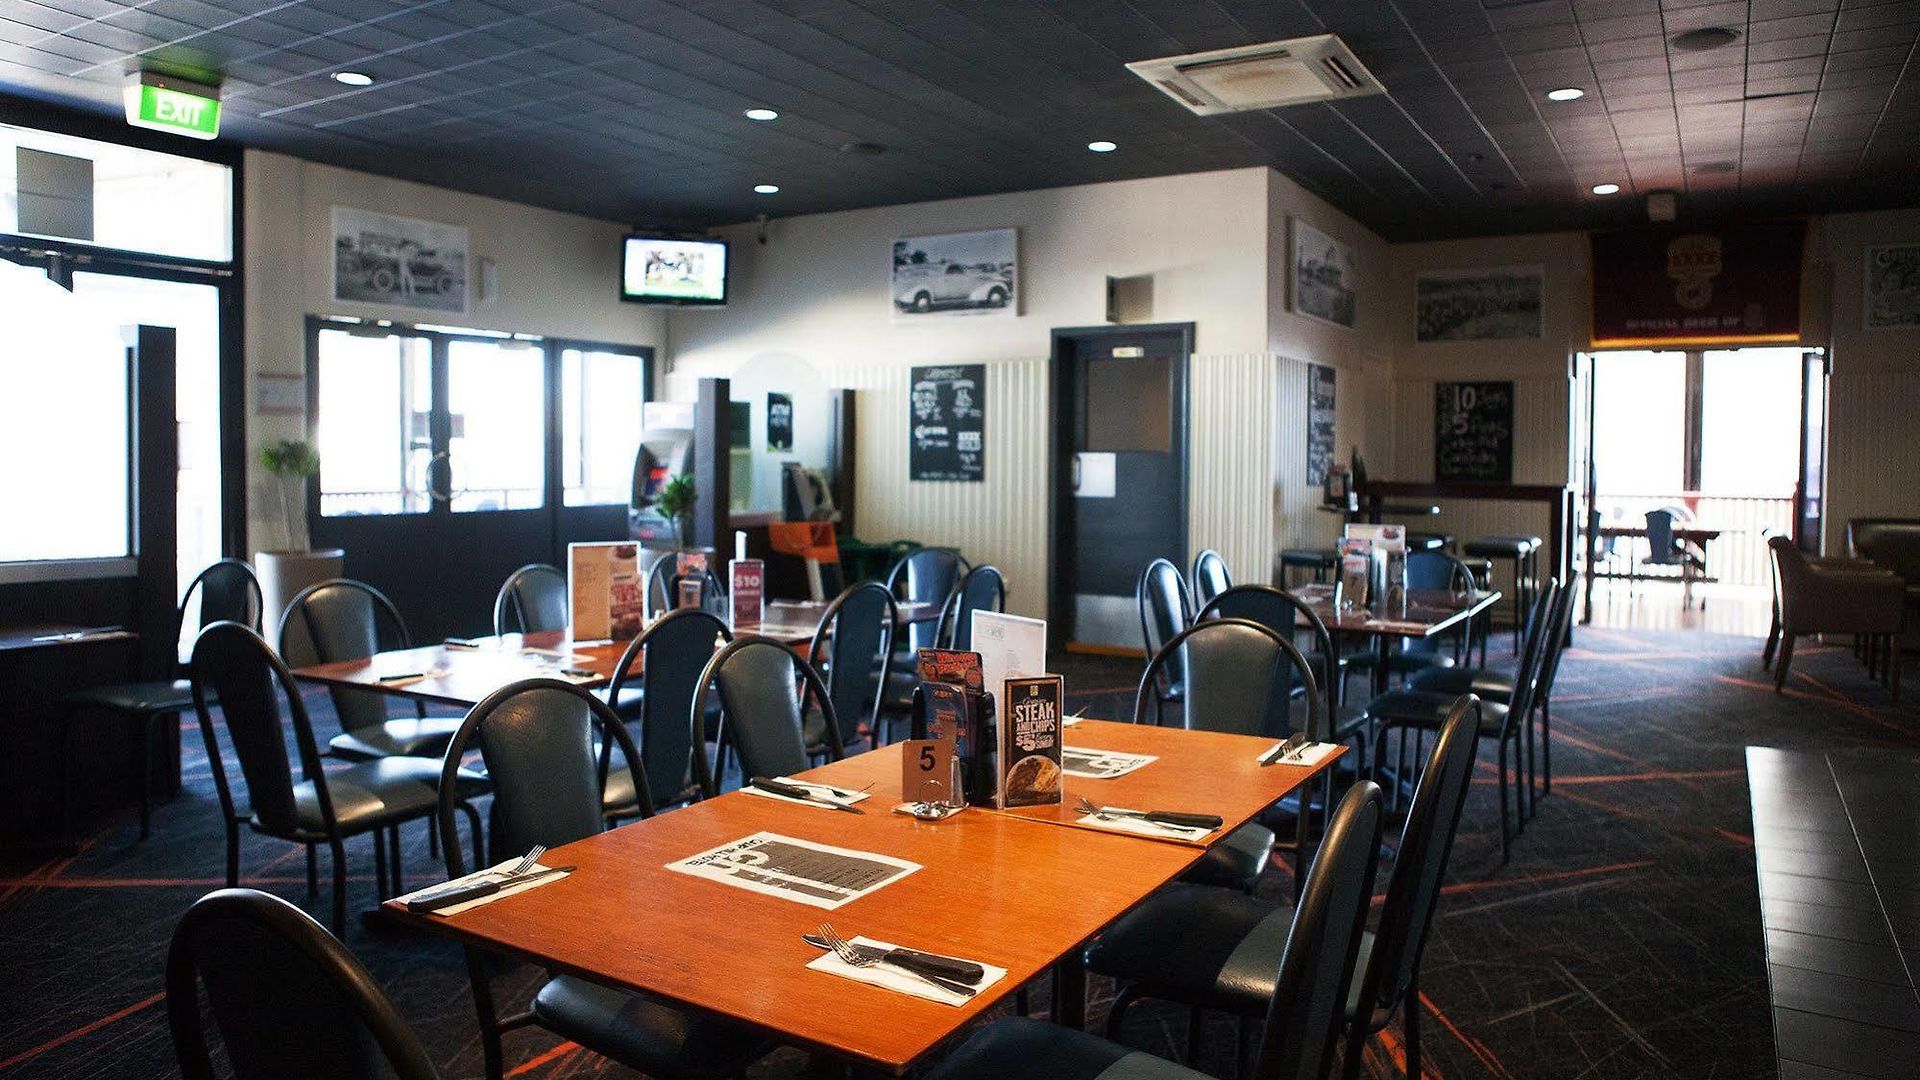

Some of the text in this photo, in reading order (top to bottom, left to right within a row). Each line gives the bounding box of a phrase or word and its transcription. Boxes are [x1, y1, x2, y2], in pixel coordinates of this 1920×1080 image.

[156, 96, 204, 126] EXIT
[1454, 385, 1476, 412] 10
[735, 575, 760, 589] $10
[1015, 702, 1055, 723] STEAK
[1031, 719, 1056, 733] CHOPS
[920, 745, 936, 772] 5
